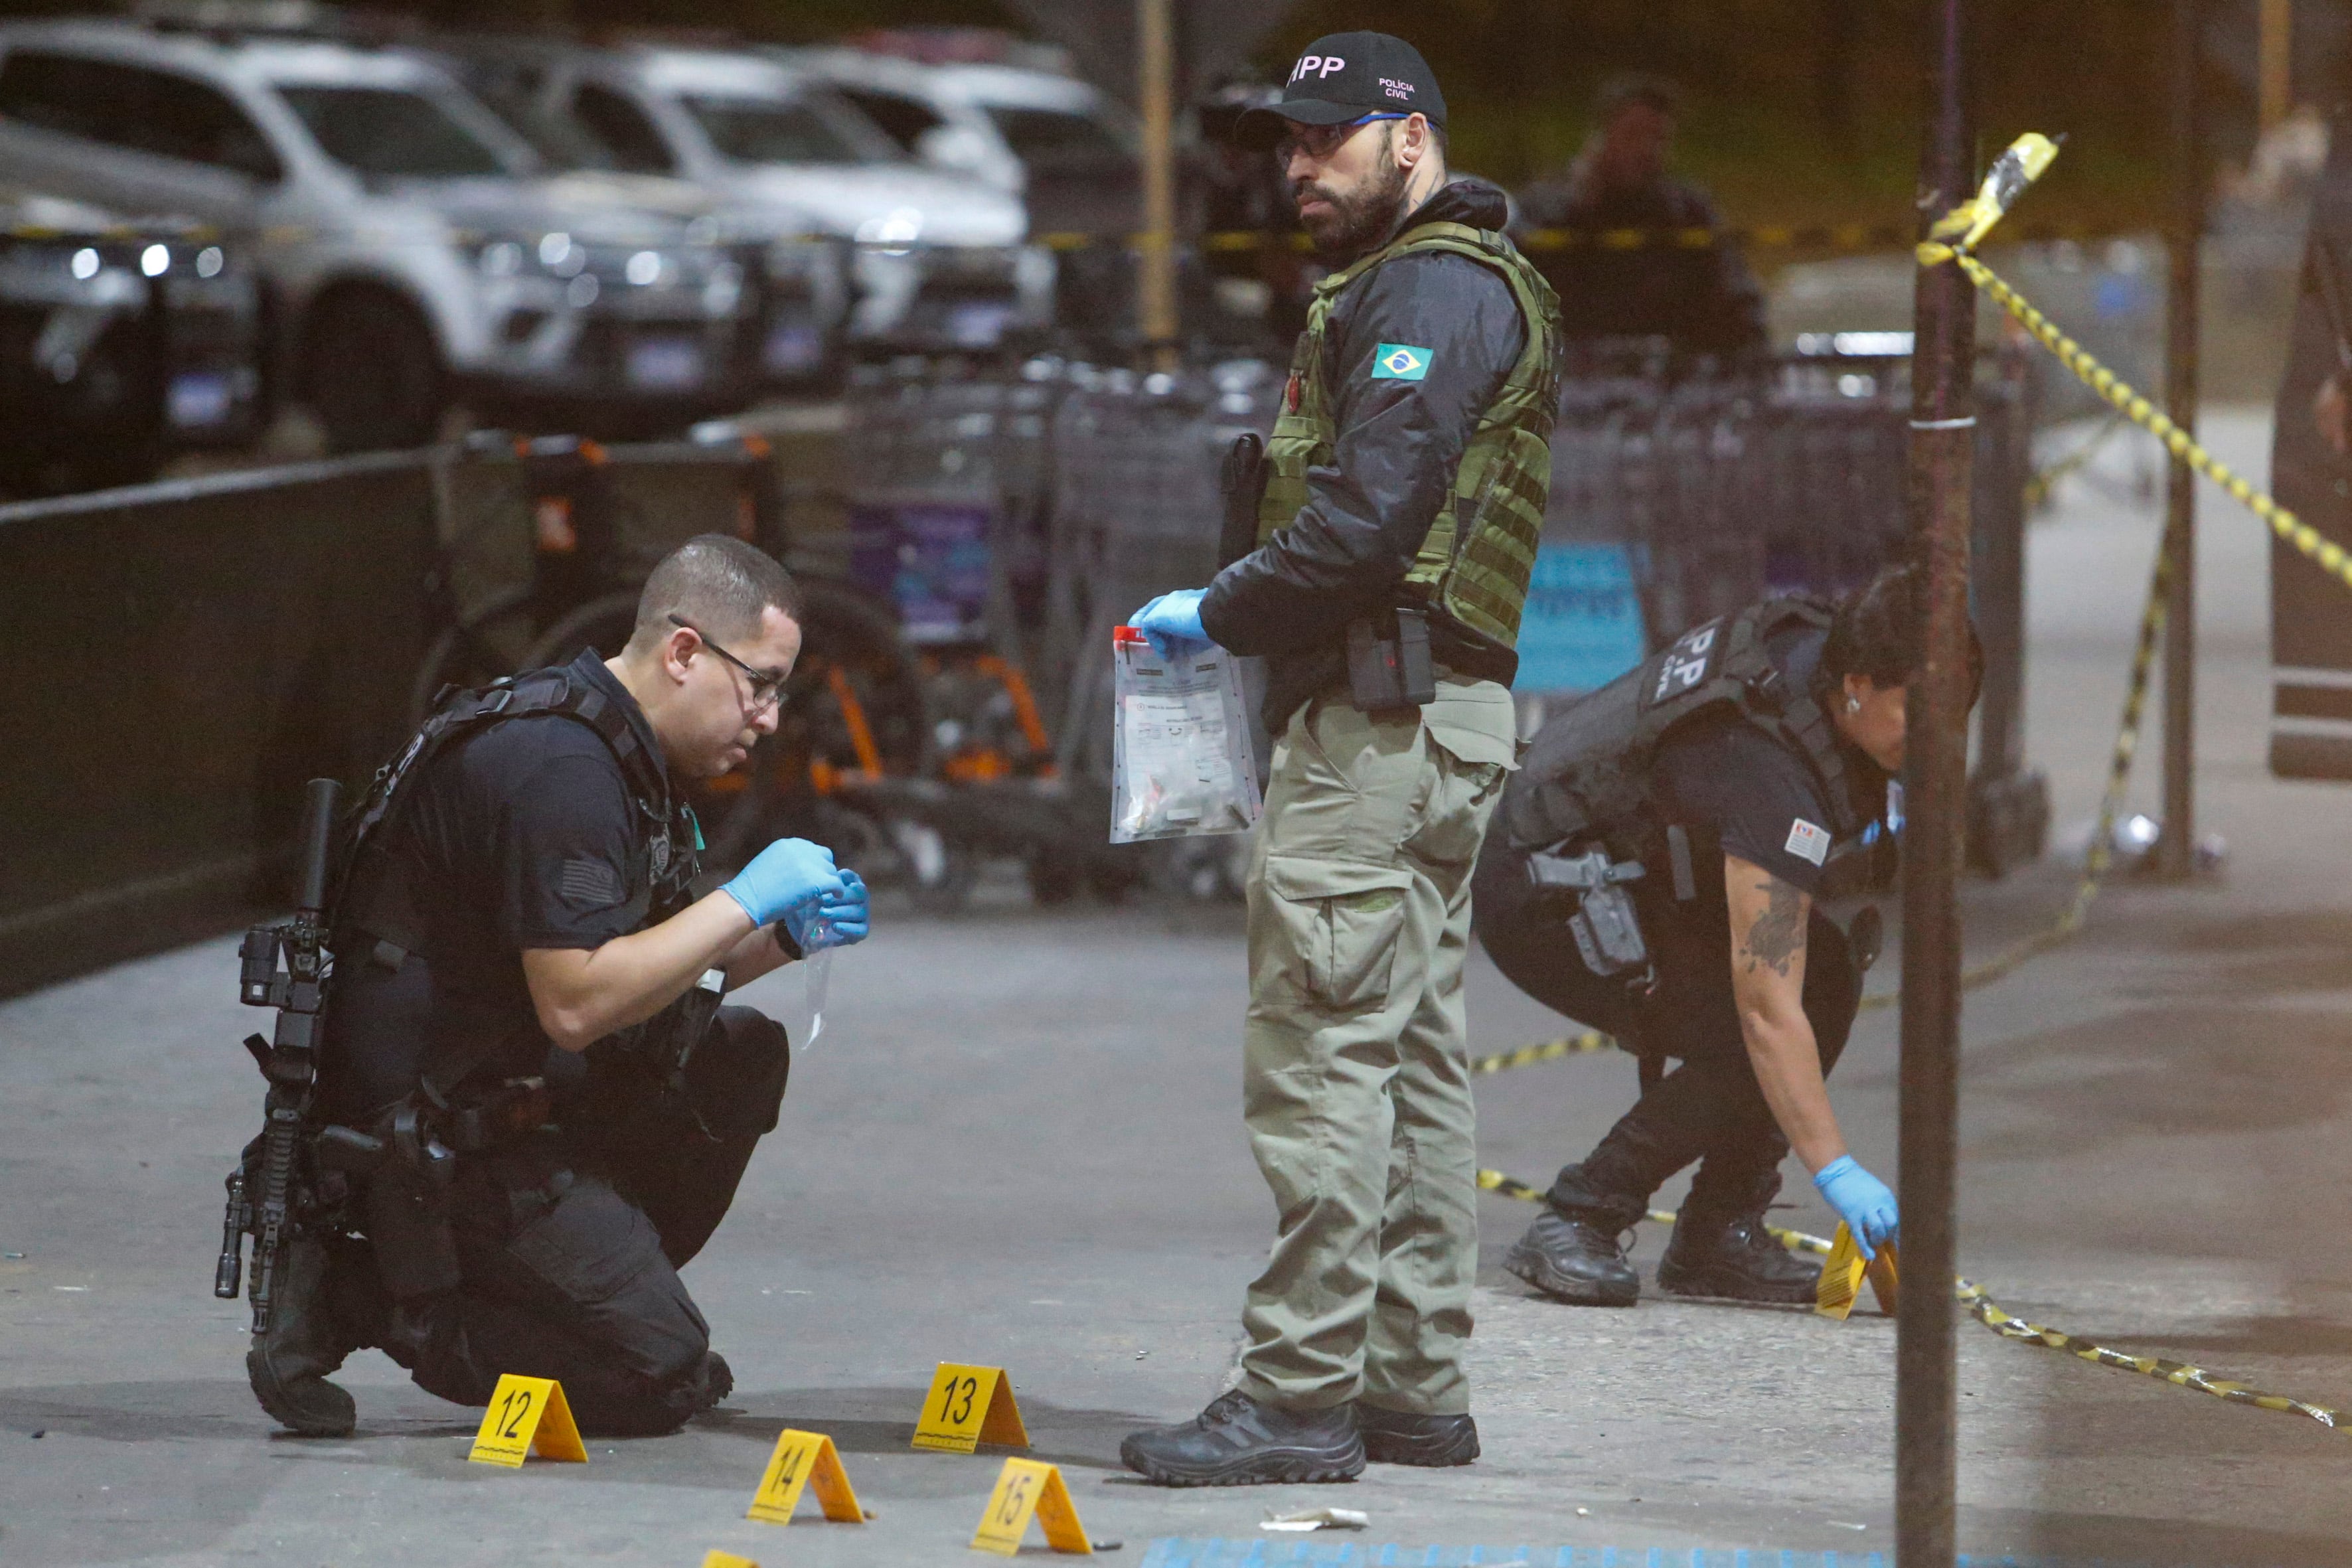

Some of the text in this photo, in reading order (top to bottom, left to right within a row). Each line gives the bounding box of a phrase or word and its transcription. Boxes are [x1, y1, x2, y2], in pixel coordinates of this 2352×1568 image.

[1379, 78, 1415, 93] POLÍCIA
[1385, 88, 1409, 100] CIVIL
[495, 1389, 531, 1438] 12
[941, 1375, 977, 1425] 13
[770, 1446, 805, 1496] 14
[996, 1474, 1032, 1526] 15
